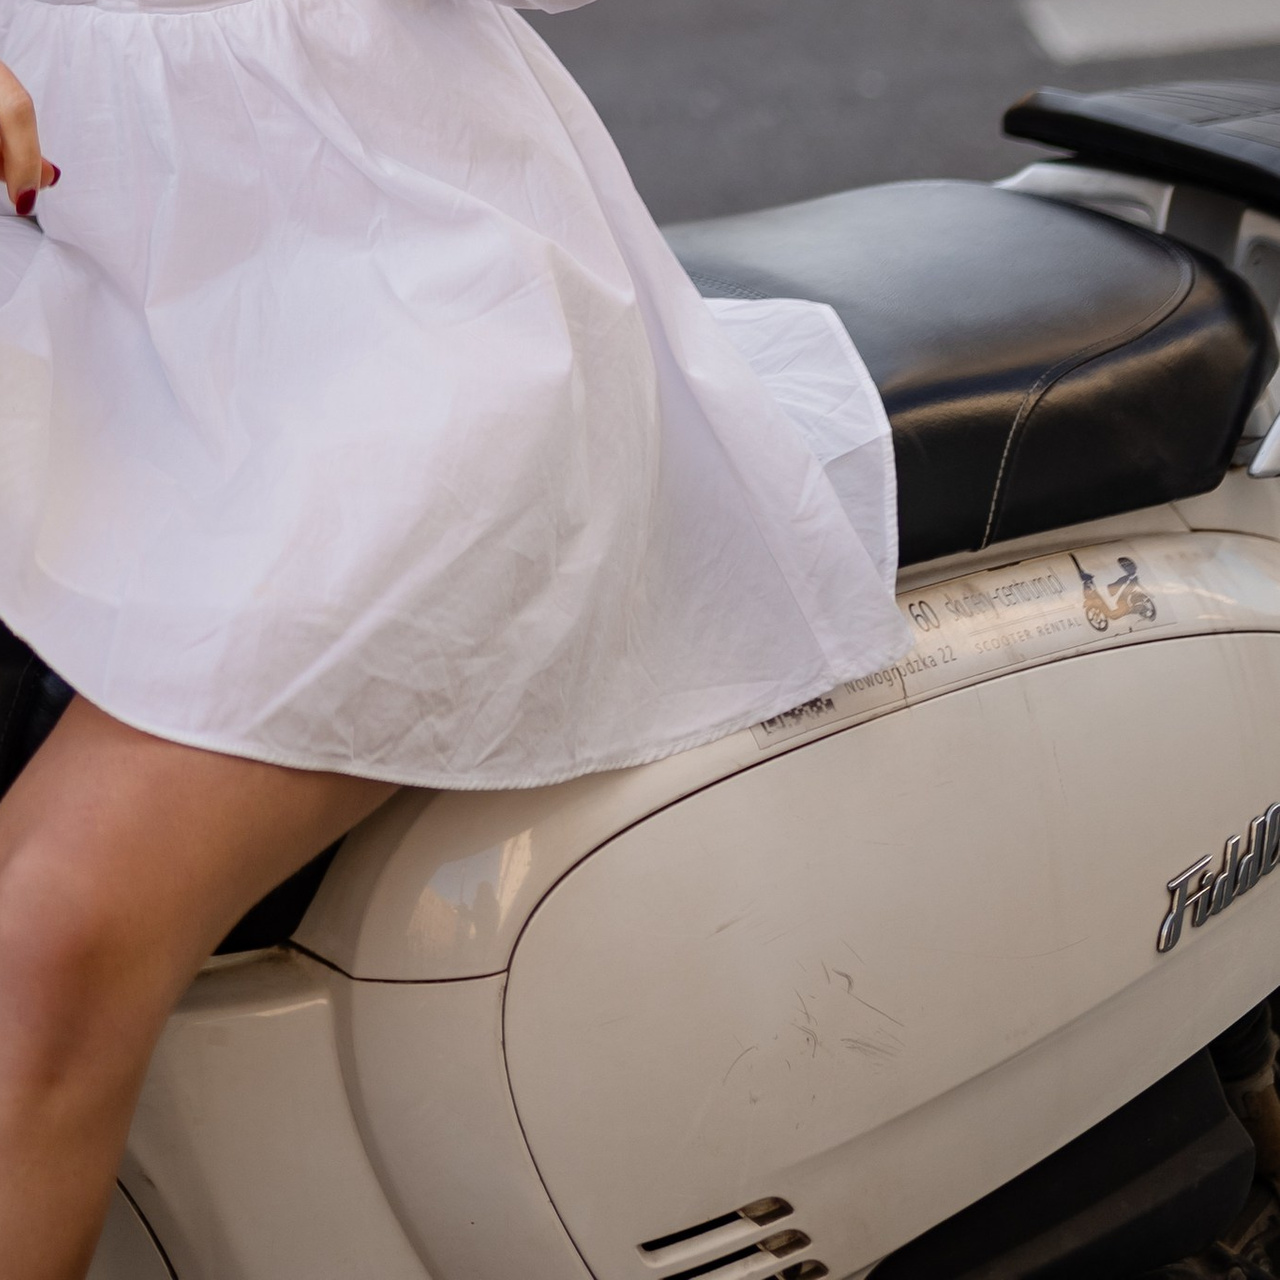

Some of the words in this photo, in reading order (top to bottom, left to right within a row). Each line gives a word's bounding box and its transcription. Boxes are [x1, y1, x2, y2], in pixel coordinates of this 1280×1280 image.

[908, 600, 941, 632] 60
[974, 627, 1033, 655] SCOOTER
[1035, 616, 1083, 639] RENTAL
[844, 653, 938, 695] Nowogrodzka
[937, 645, 958, 664] 22
